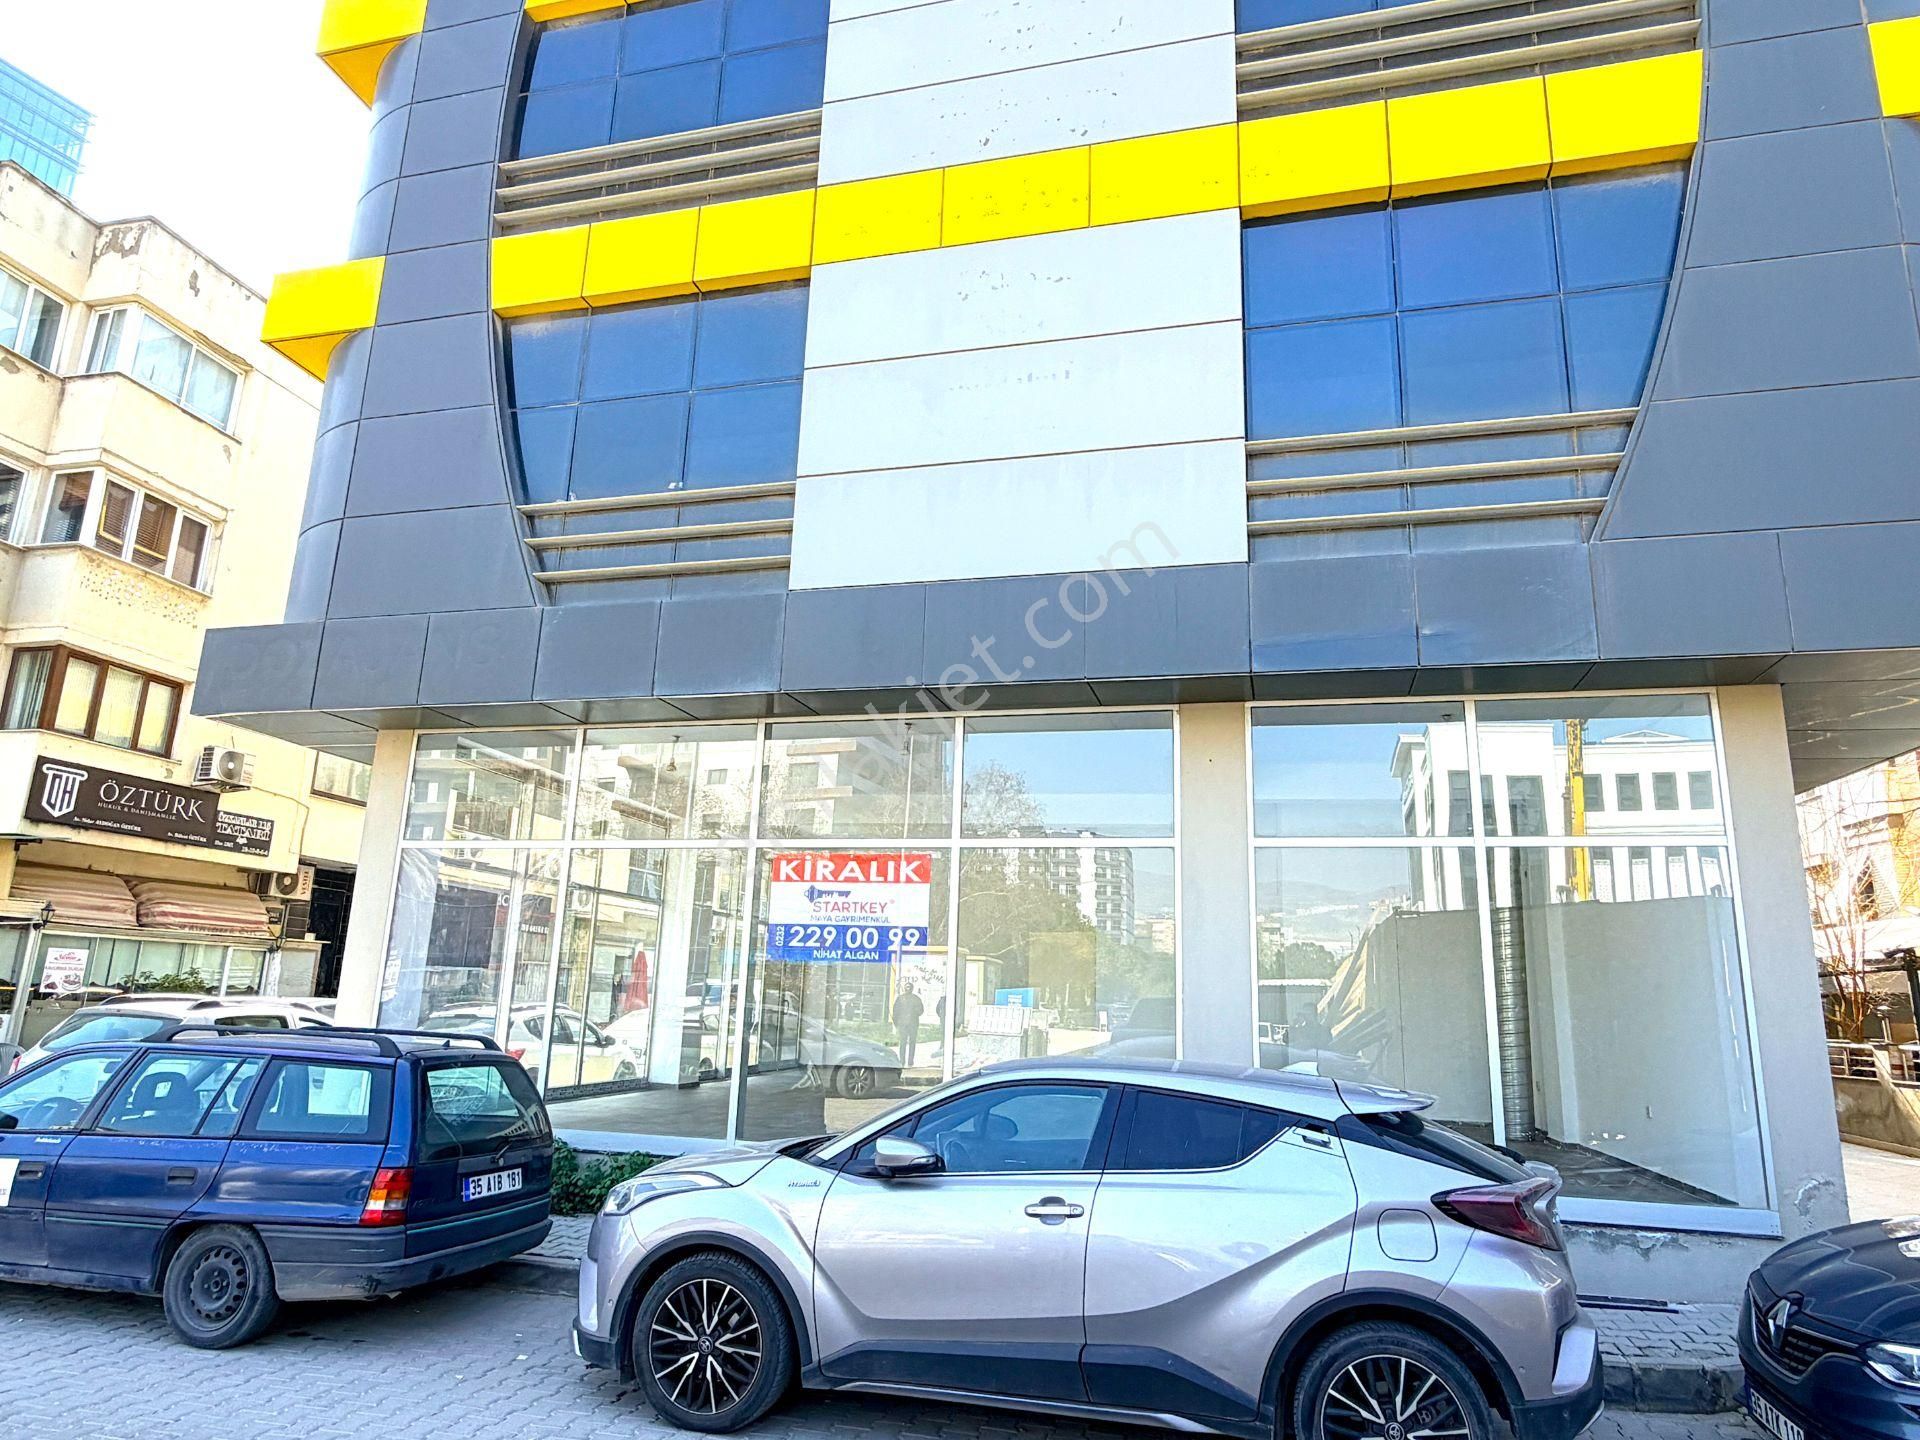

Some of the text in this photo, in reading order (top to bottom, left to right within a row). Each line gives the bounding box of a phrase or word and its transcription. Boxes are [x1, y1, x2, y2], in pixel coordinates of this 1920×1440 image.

[100, 779, 206, 823] ÖZTÜRK
[780, 855, 922, 882] KİRALIK
[812, 901, 888, 914] STARTKEY
[775, 926, 785, 947] 0232
[788, 926, 920, 949] 229 00 99
[813, 948, 880, 960] NİHAT ALGAN
[471, 1178, 482, 1196] 35
[487, 1175, 502, 1193] AIB
